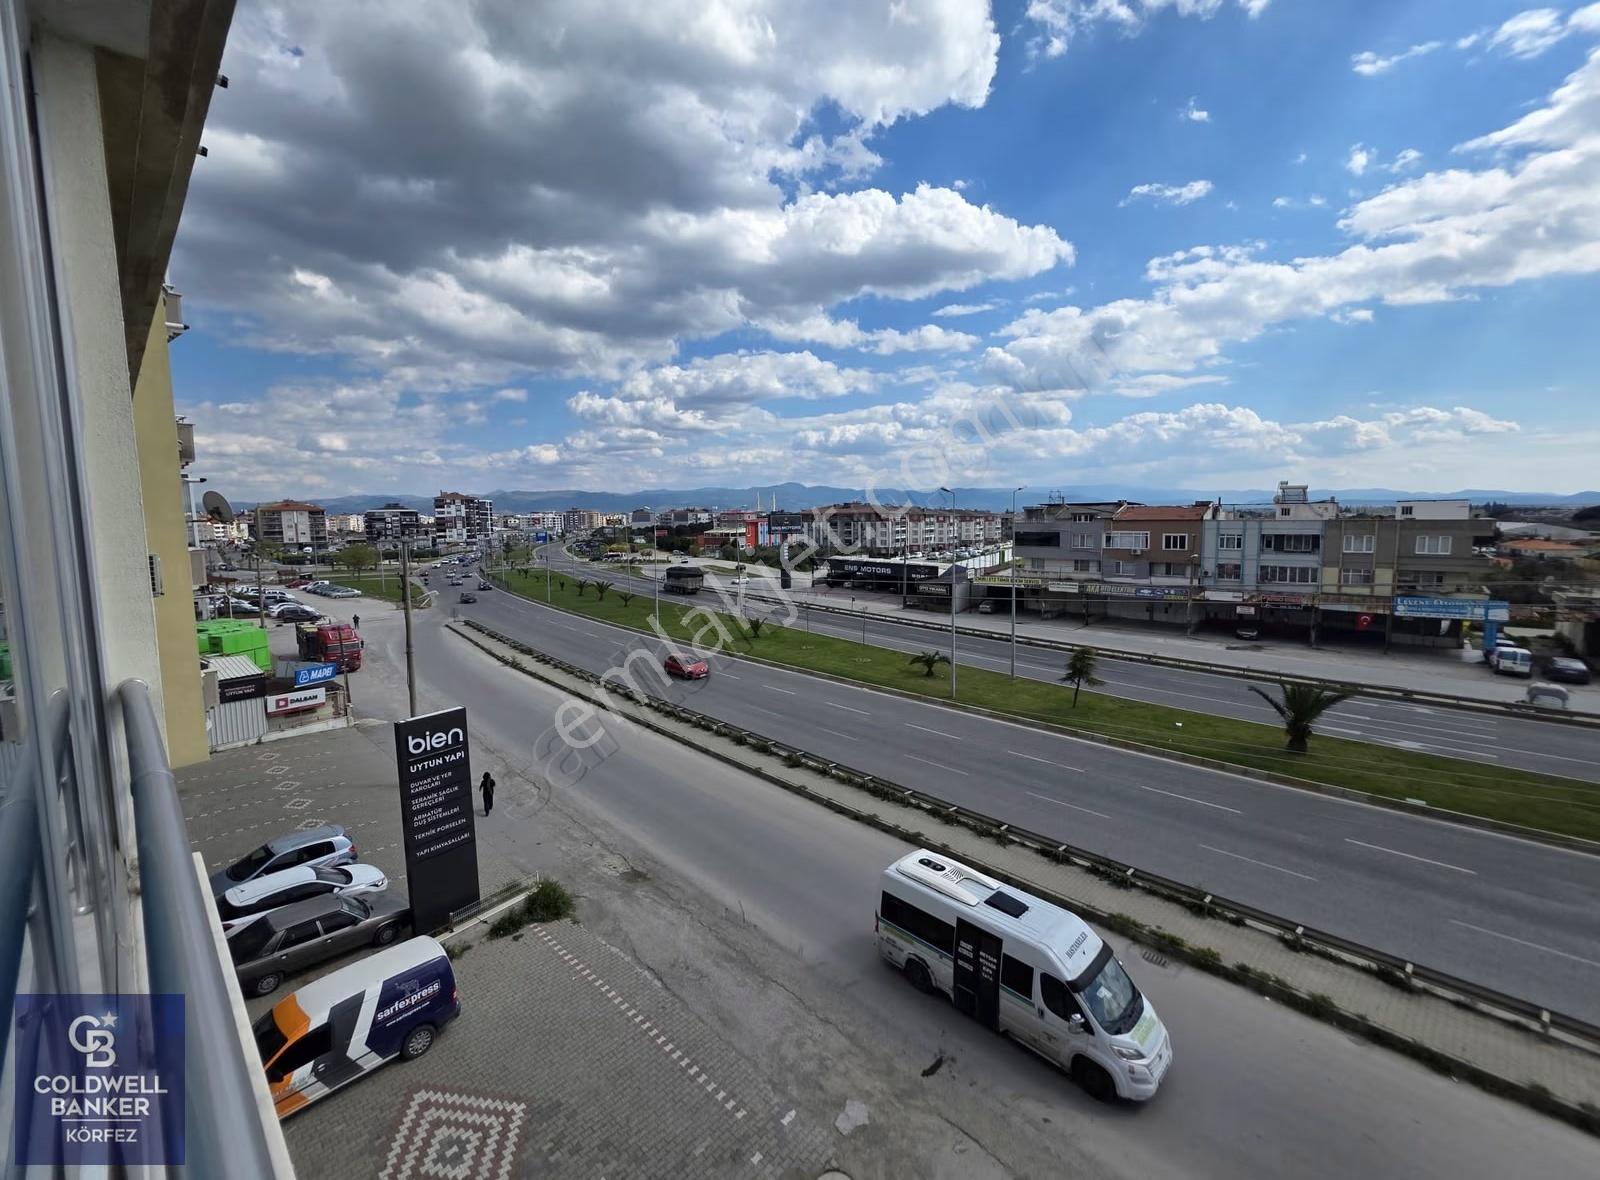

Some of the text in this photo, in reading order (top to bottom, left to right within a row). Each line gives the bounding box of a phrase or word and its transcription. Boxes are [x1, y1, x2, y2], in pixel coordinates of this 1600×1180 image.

[860, 566, 892, 574] MOTORS
[1086, 584, 1100, 593] AKA
[310, 666, 332, 680] MAPEI
[408, 728, 464, 754] bien
[410, 750, 464, 772] UYTUN YAPI
[410, 777, 432, 788] DUVAR
[410, 781, 440, 794] KAROLARI
[411, 786, 459, 804] SERAMİK SAĞLIK
[412, 796, 445, 810] GEREÇLERİ
[414, 808, 442, 821] ARMATÜR
[414, 806, 460, 828] DUŞ SİSTEMLERİ
[414, 818, 466, 840] TEKNİK PORSELEN
[416, 832, 470, 857] YAPI KİMYASALLARI
[378, 982, 439, 1020] sarfexpress
